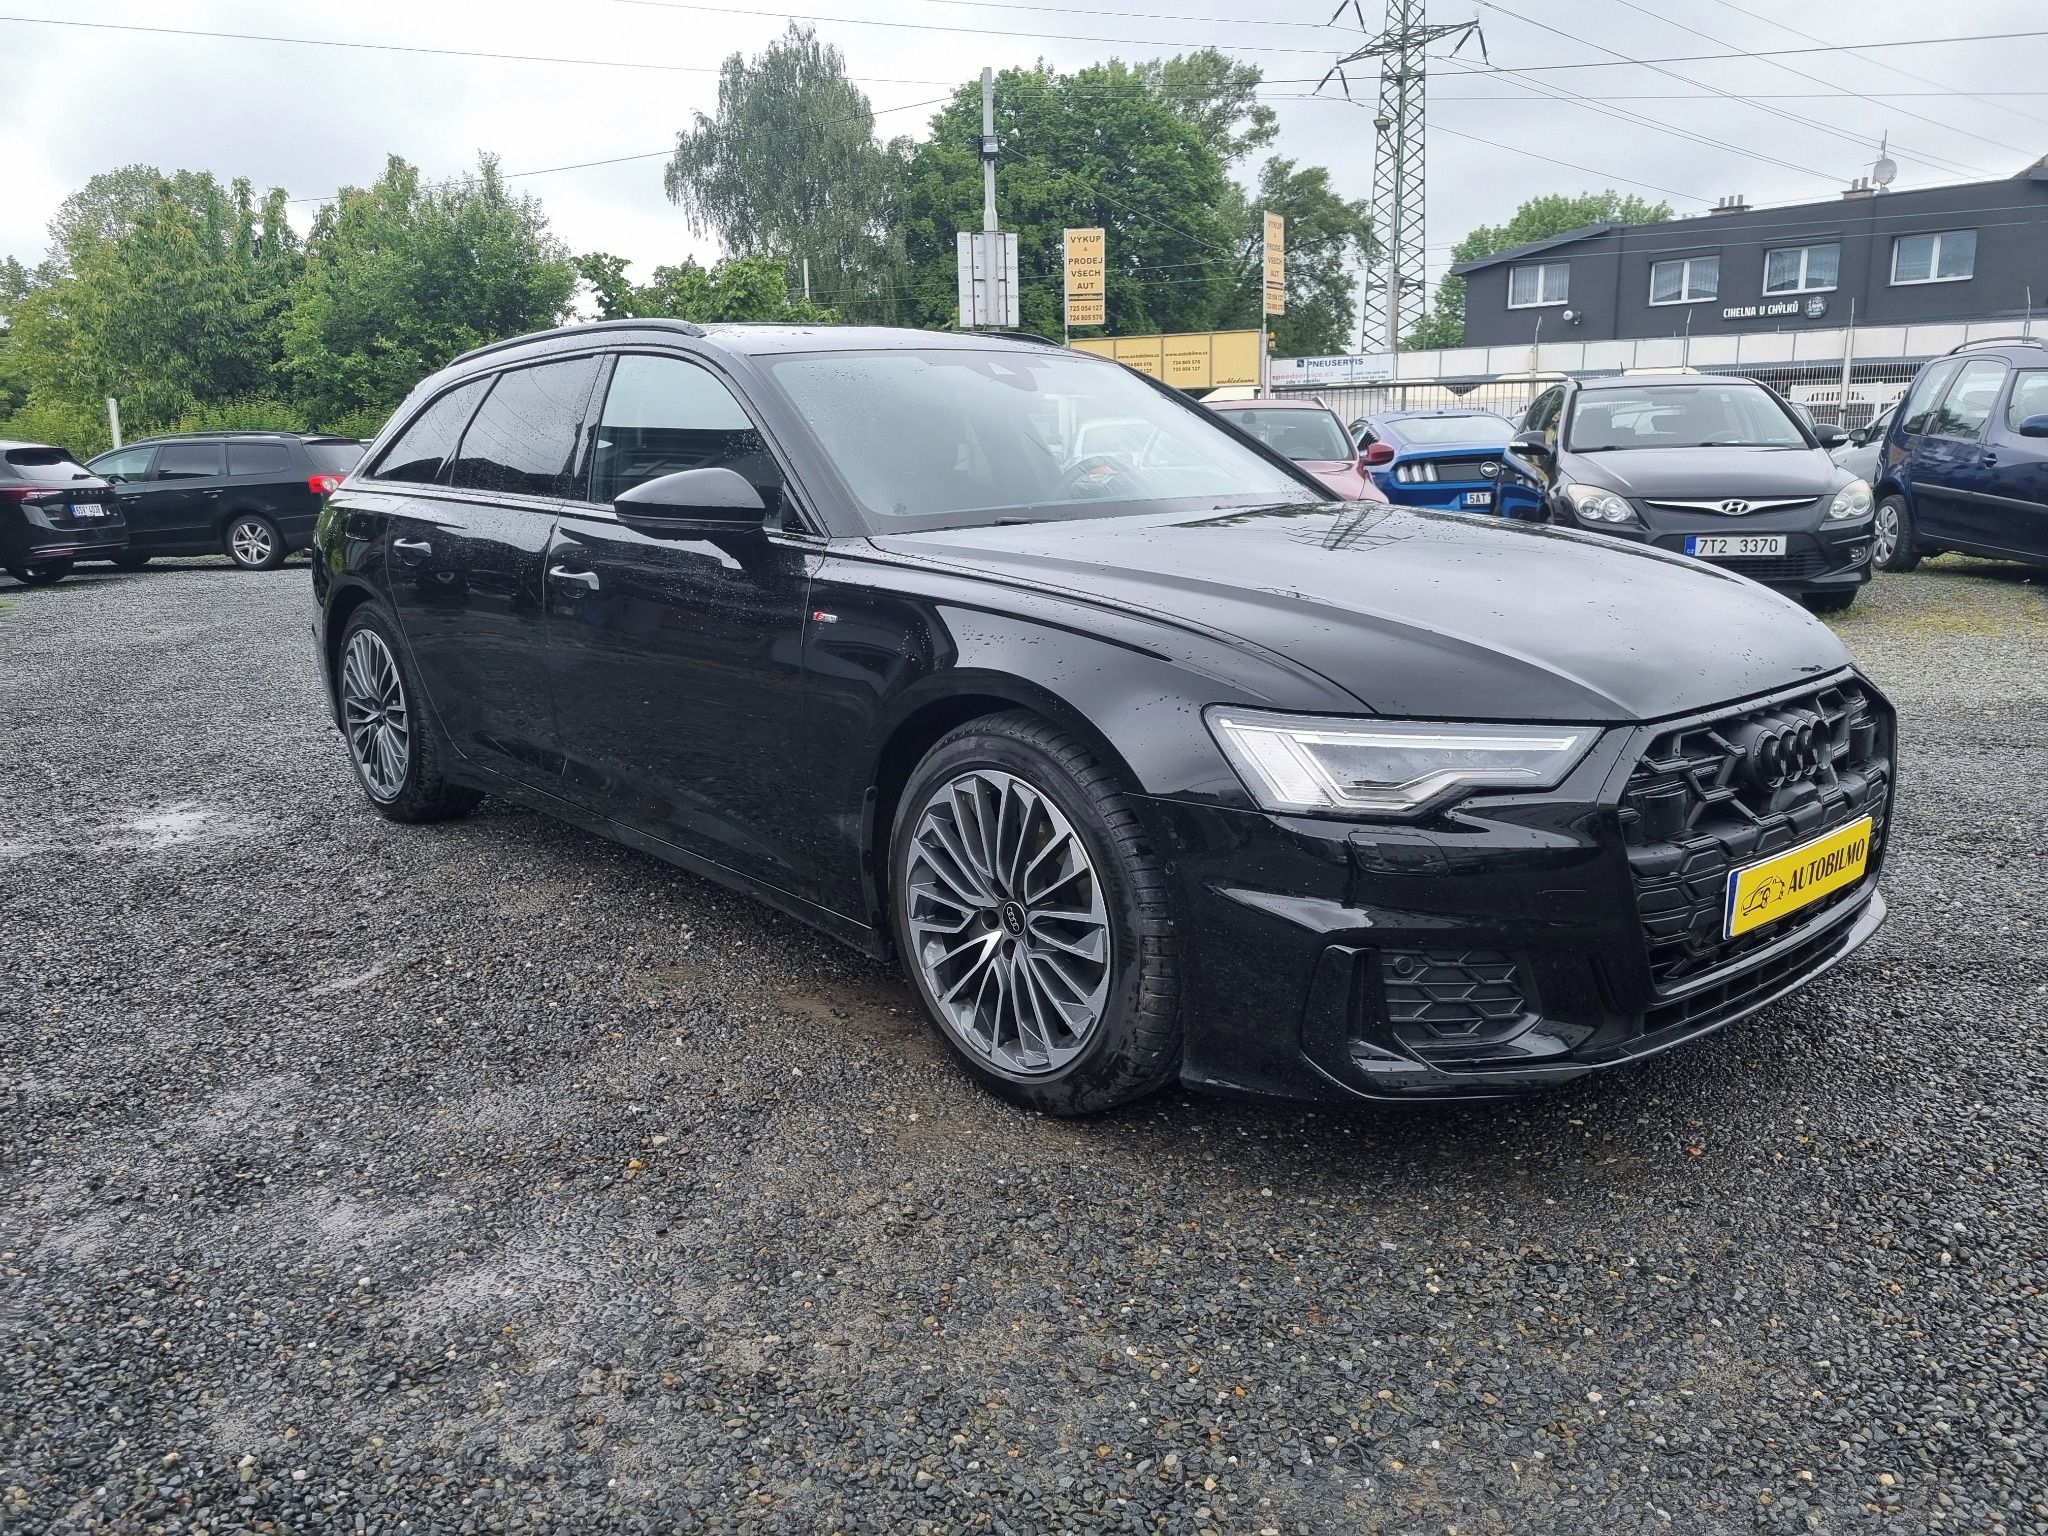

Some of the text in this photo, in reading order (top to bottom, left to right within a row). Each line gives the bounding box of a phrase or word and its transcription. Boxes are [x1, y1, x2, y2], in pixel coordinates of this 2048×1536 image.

[1070, 234, 1102, 243] VÝKUP
[1068, 257, 1103, 265] PRODEJ
[1070, 269, 1101, 277] VŠECH
[1723, 306, 1756, 318] CIHELNA
[1759, 305, 1765, 315] U
[1307, 358, 1364, 368] PNEUSERVIS
[1469, 493, 1487, 504] 5AT
[1699, 539, 1728, 554] 7T2
[1739, 538, 1778, 553] 3370
[1787, 838, 1865, 895] AUTOBILMO
